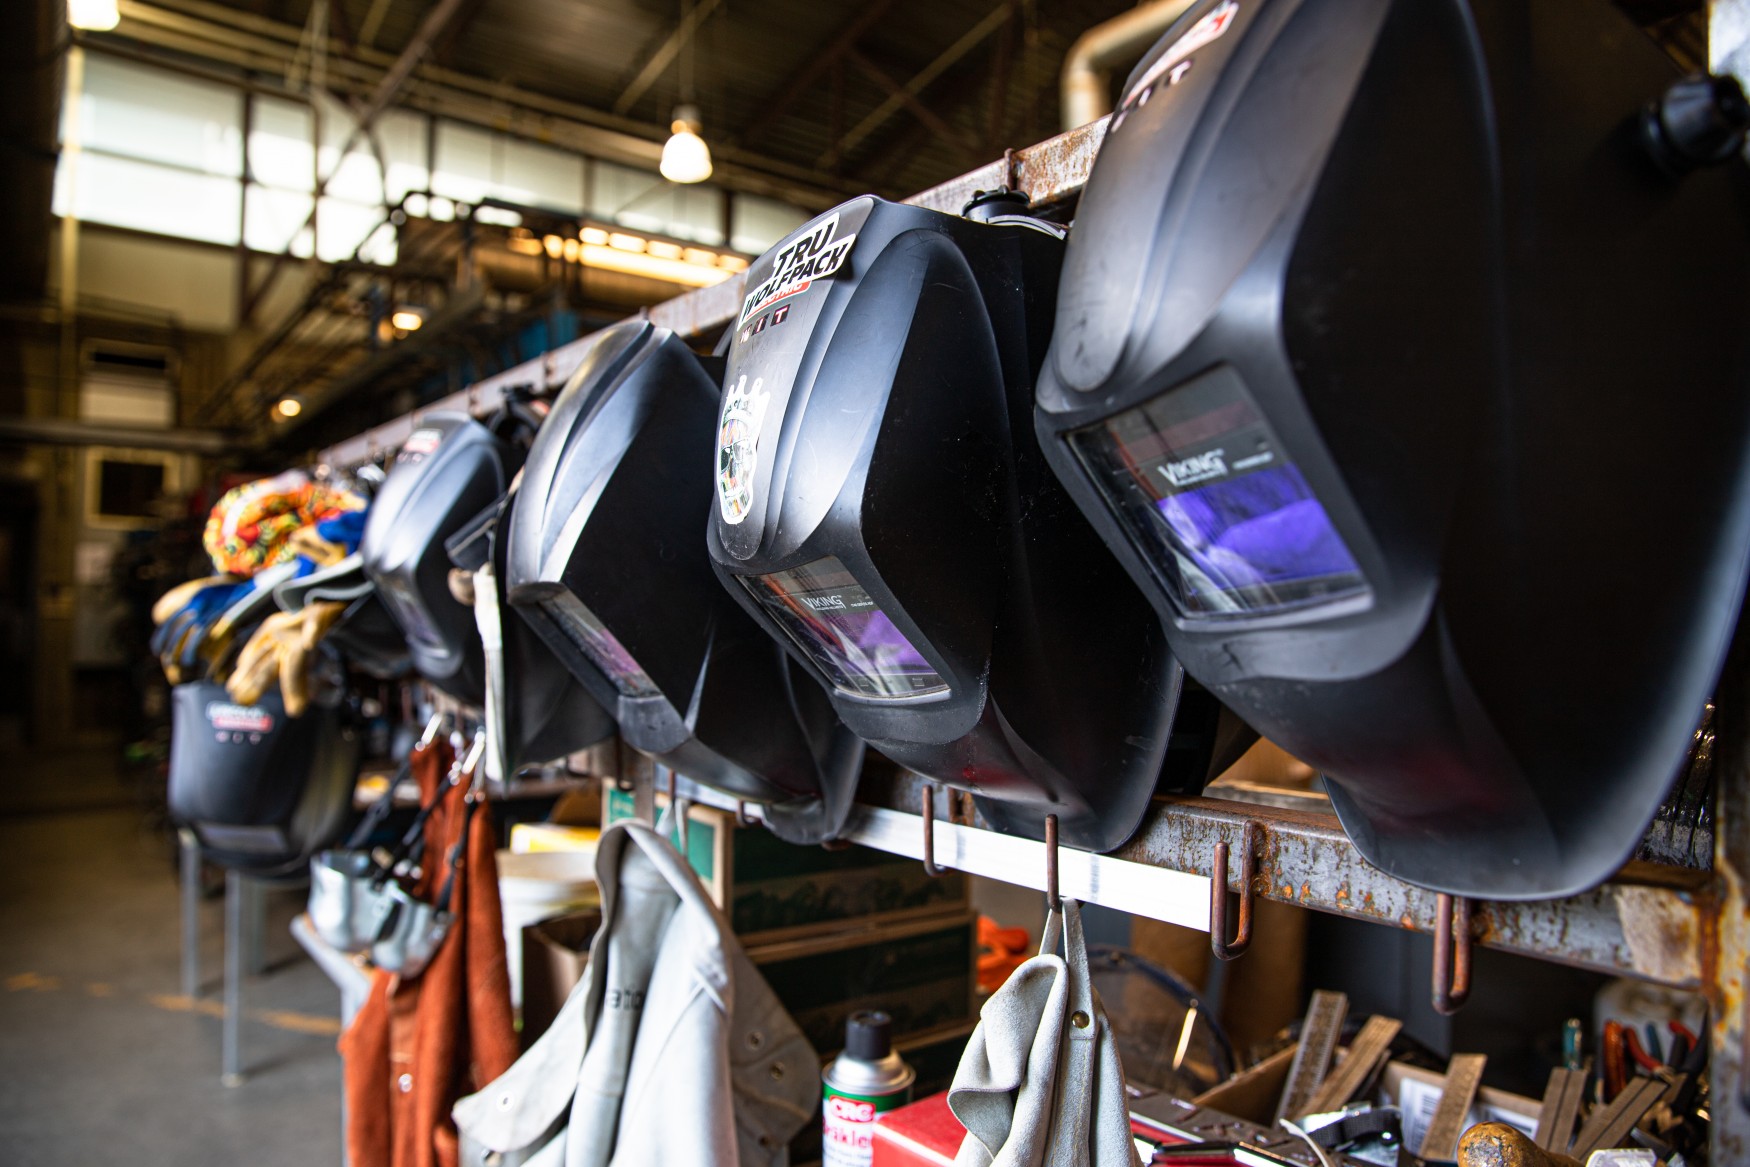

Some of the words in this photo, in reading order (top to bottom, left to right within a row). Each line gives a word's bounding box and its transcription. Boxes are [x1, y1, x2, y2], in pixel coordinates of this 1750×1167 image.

[774, 221, 835, 277] TRU
[742, 242, 849, 321] WOLFPACK
[1157, 447, 1228, 487] VIKING
[801, 595, 847, 611] VIKING
[830, 1098, 874, 1122] CRC
